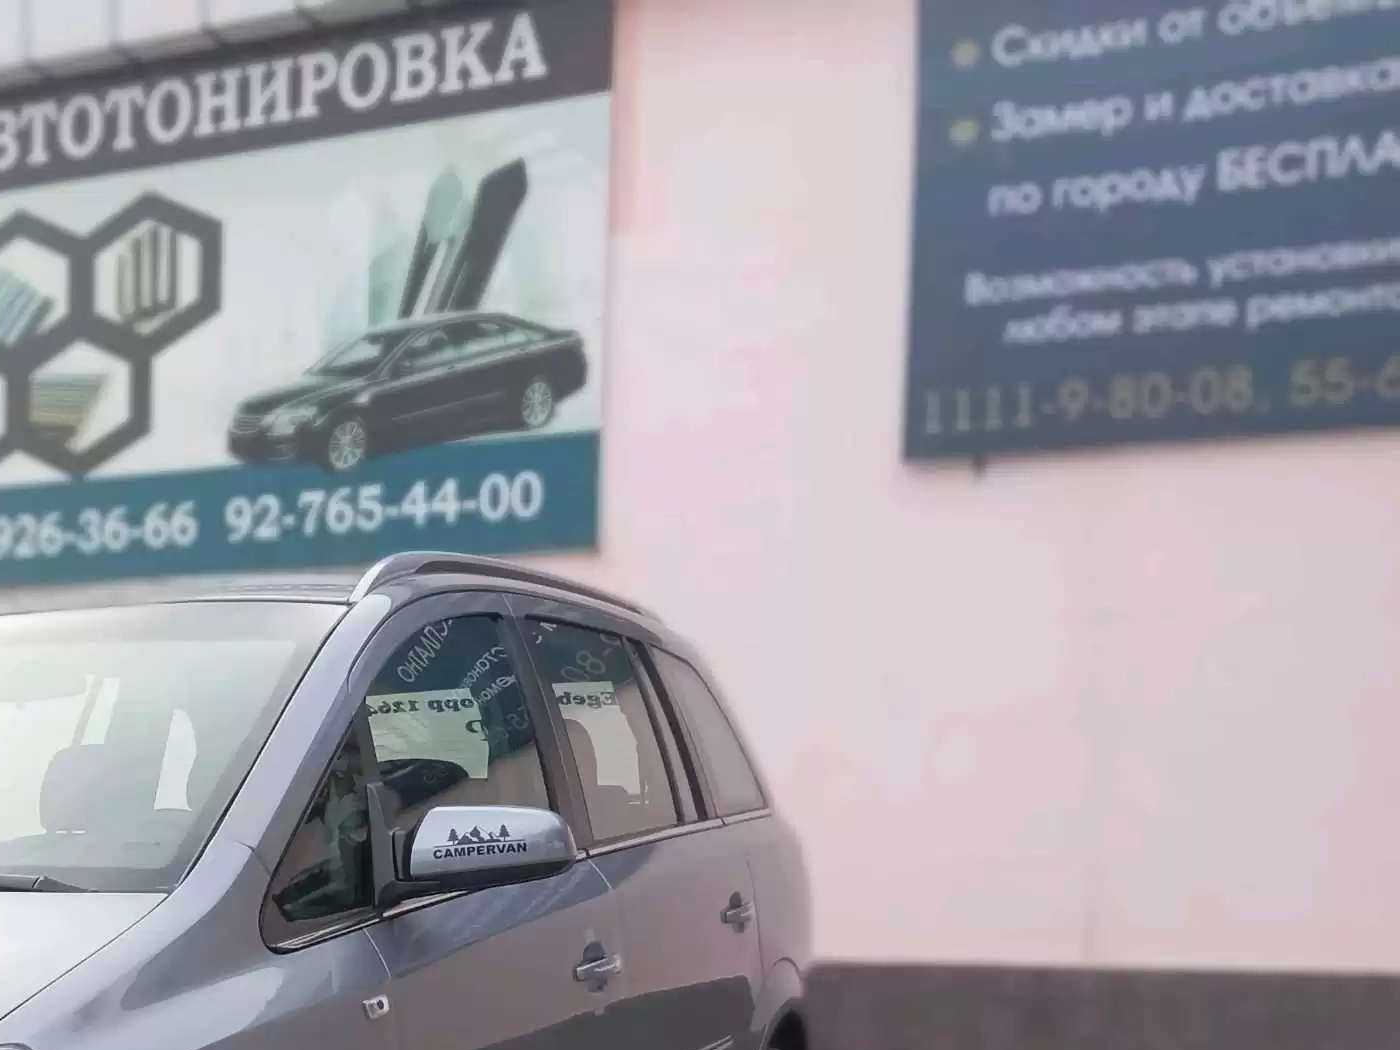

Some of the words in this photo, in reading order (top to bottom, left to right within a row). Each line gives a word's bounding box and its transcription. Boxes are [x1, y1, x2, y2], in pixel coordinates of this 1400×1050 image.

[991, 19, 1148, 66] Скидки
[1157, 9, 1207, 44] от
[989, 97, 1134, 142] Замер
[1143, 91, 1174, 122] и
[985, 183, 1043, 217] по
[1051, 164, 1207, 214] городу
[225, 471, 544, 543] 92-765-44-00
[433, 842, 528, 860] CAMPERVAN
